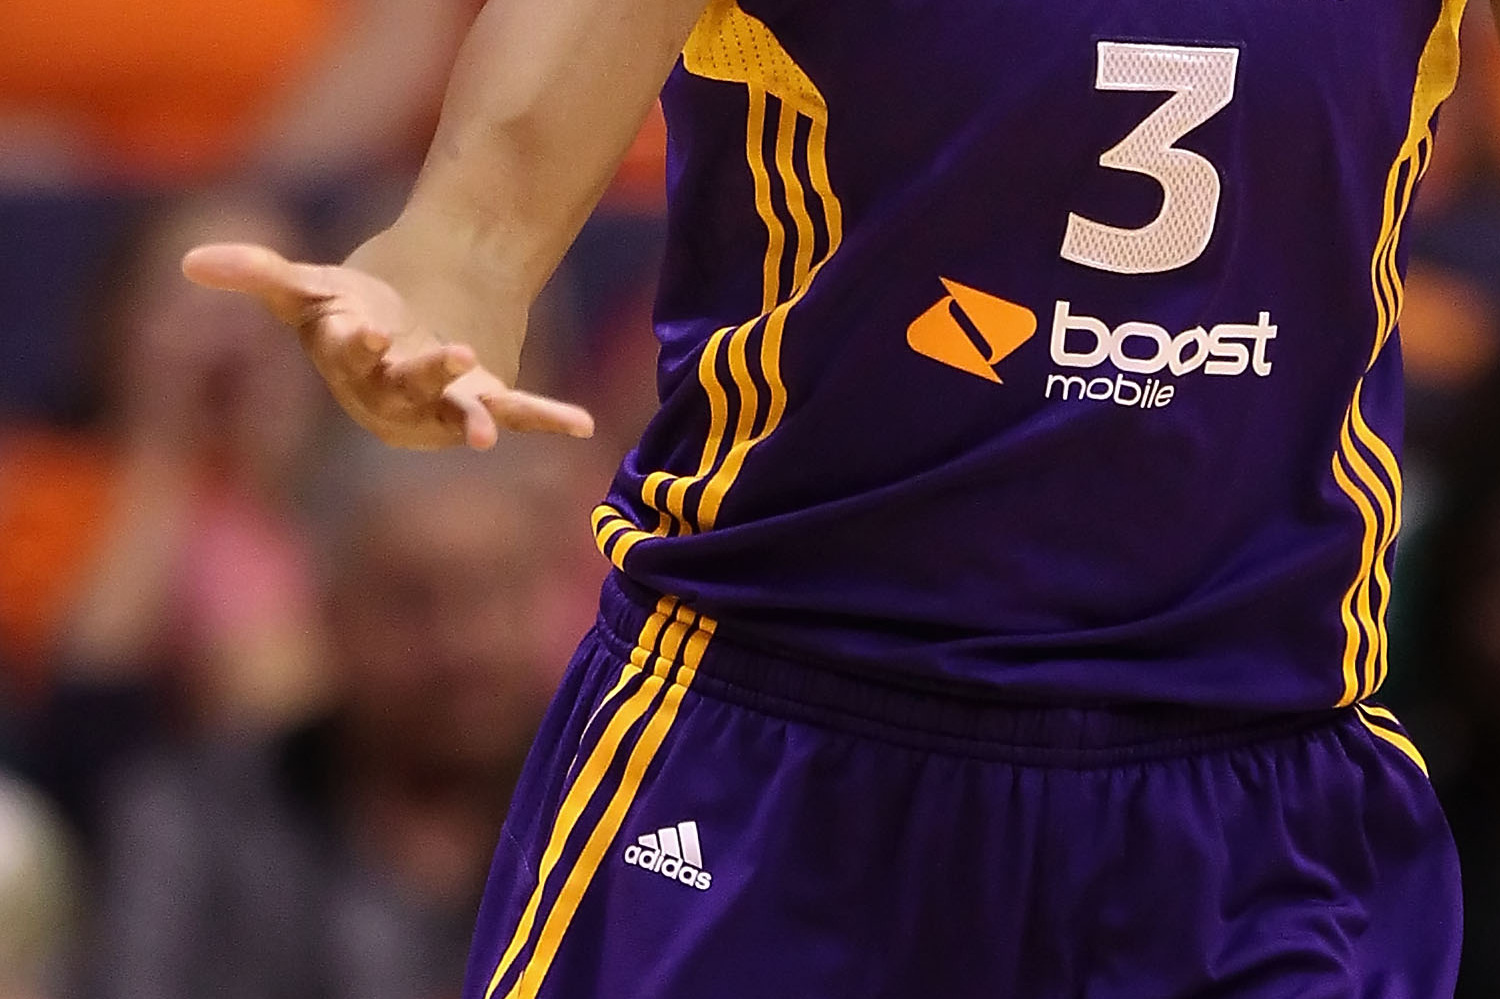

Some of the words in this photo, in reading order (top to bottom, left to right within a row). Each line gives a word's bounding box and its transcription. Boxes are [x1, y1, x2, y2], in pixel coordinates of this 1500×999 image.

[1060, 40, 1240, 275] 3
[1050, 300, 1278, 377] boost
[1044, 373, 1175, 409] mobile
[624, 845, 712, 890] adidas
